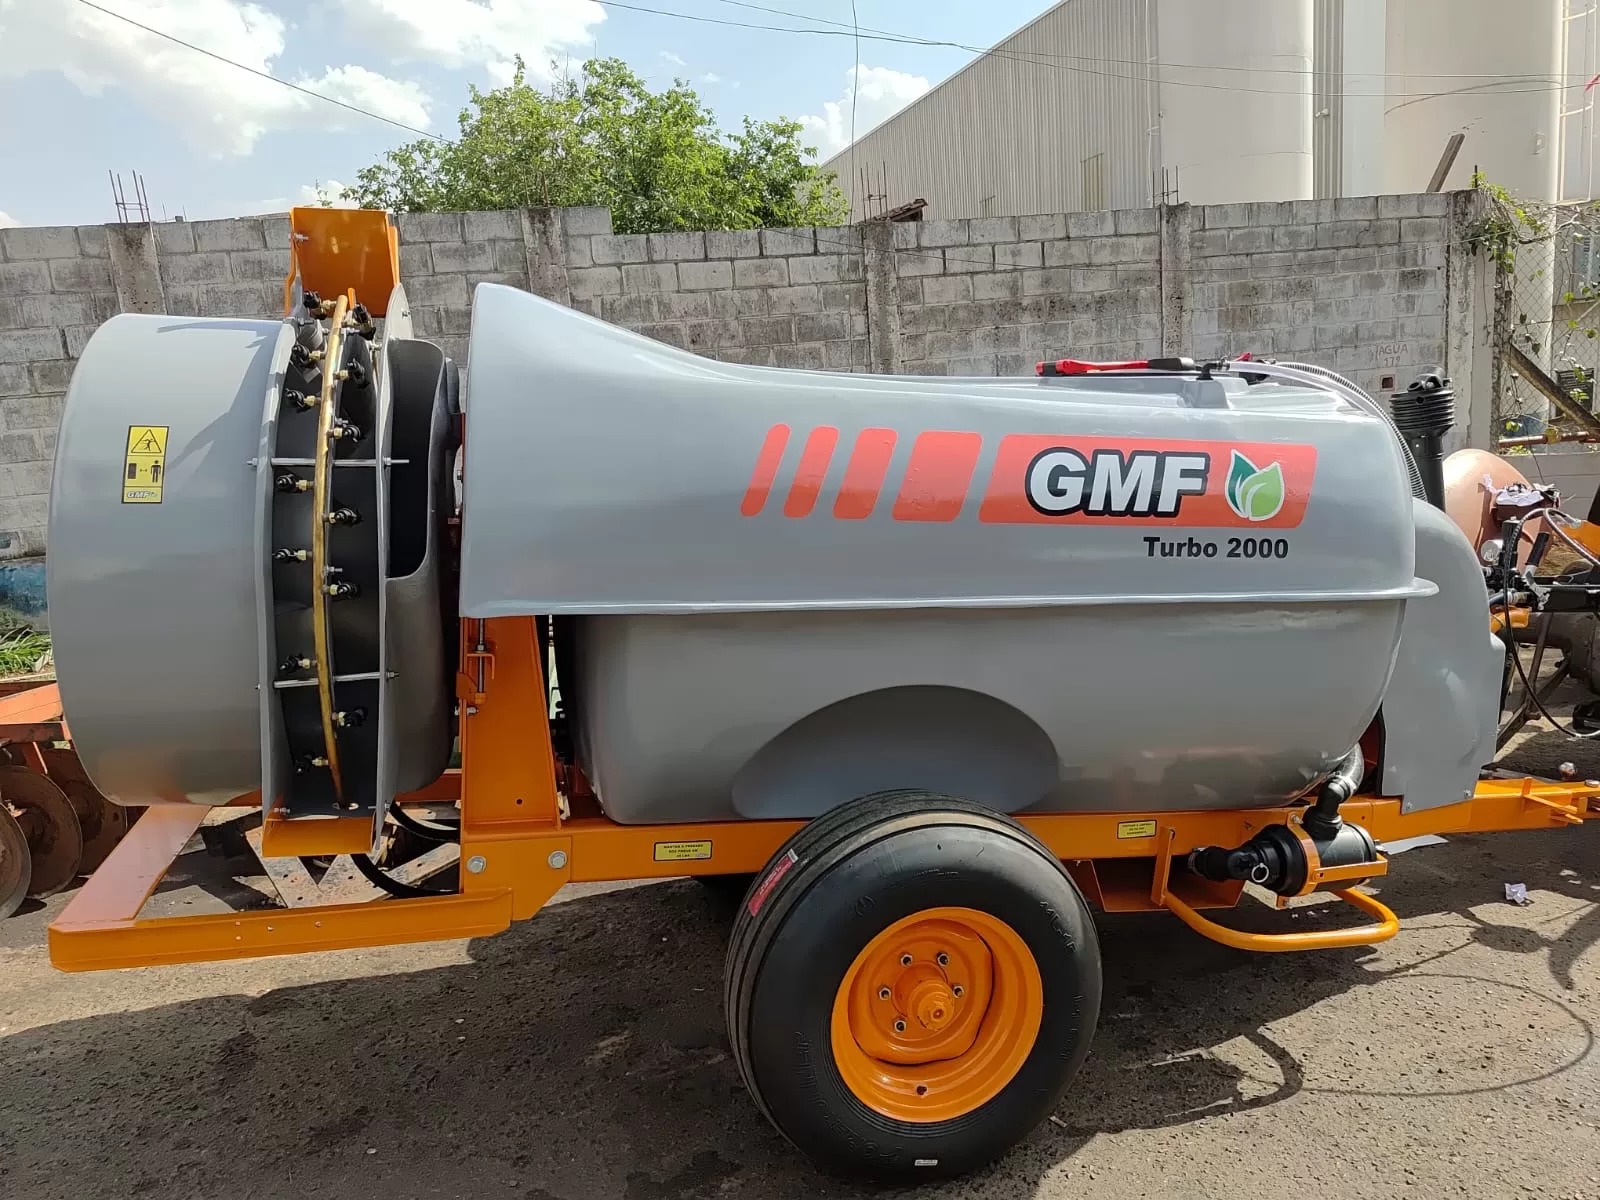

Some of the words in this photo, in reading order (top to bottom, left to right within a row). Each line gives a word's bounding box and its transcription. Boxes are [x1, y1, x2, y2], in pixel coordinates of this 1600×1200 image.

[1025, 447, 1209, 517] GMF
[1143, 536, 1218, 558] Turbo
[1226, 537, 1289, 559] 2000
